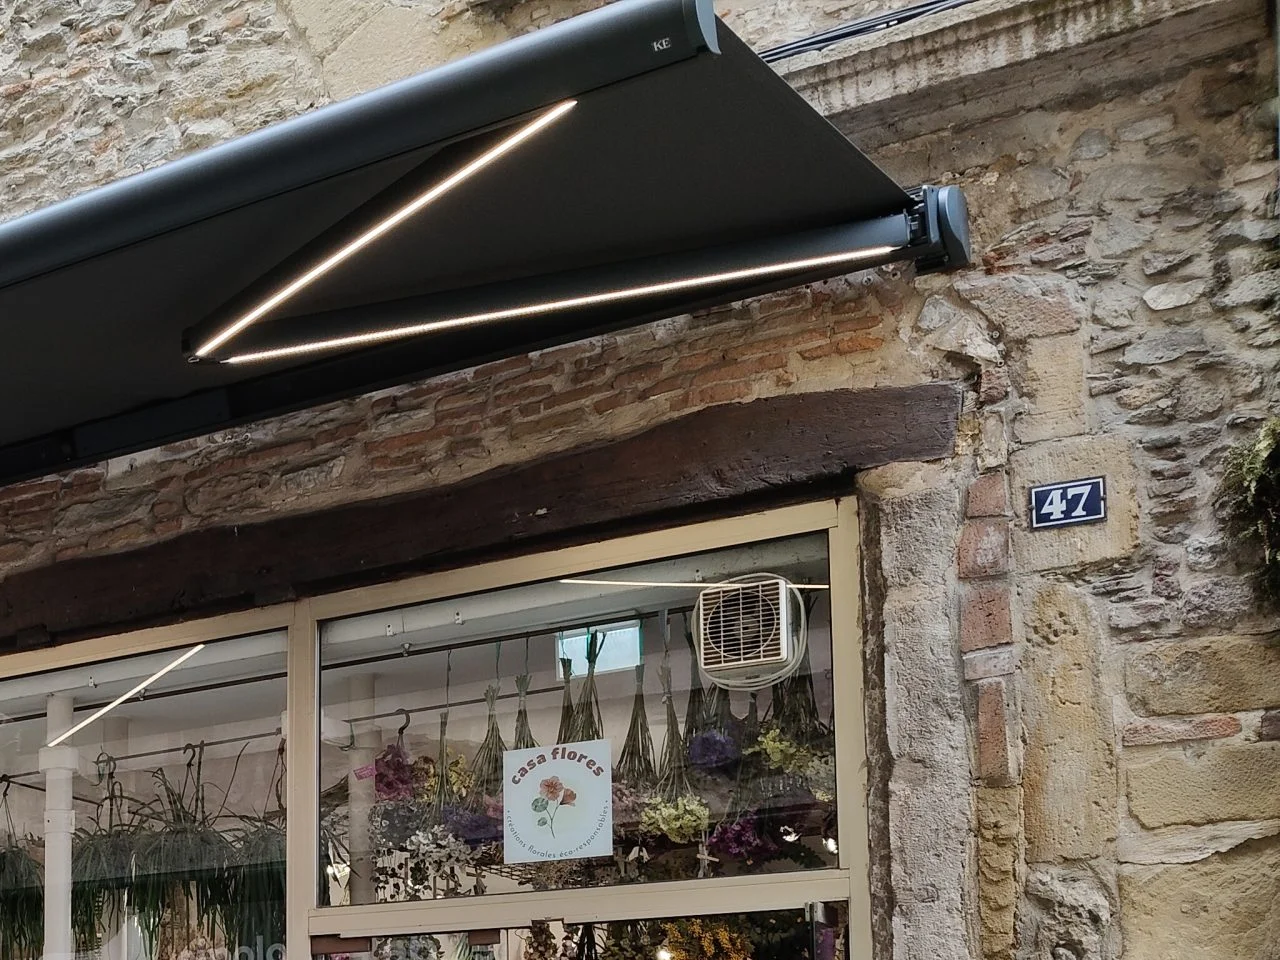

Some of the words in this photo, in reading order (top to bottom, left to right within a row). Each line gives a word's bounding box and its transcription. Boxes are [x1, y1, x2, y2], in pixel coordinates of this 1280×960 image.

[653, 37, 671, 52] KE
[1040, 484, 1093, 520] 47
[511, 753, 547, 785] casa
[550, 747, 605, 777] flores
[506, 815, 527, 848] créations
[527, 844, 556, 859] florales
